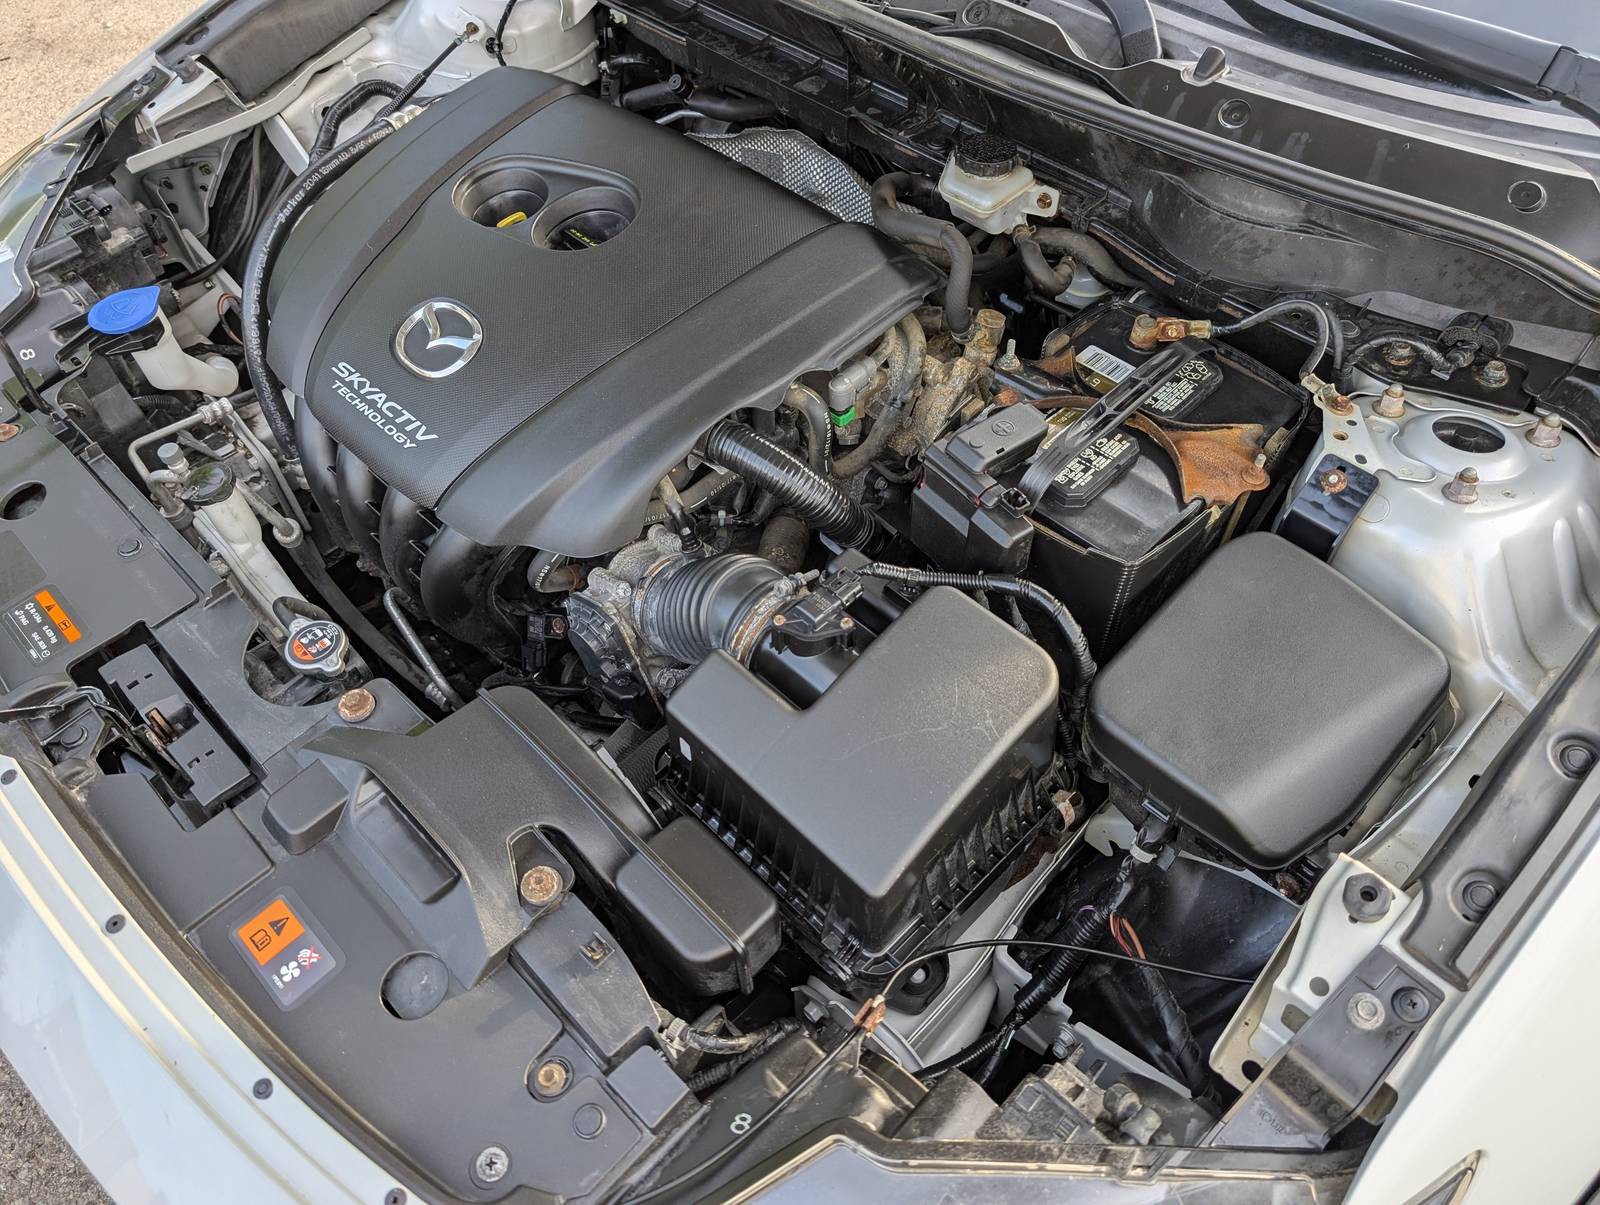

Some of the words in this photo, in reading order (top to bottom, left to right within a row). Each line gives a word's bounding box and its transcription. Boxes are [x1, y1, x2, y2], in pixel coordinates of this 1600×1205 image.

[302, 172, 322, 191] 2041
[19, 348, 36, 361] 8
[331, 361, 439, 441] SKYACTIV
[332, 380, 418, 449] TECHNOLOGY
[730, 1112, 753, 1135] 8
